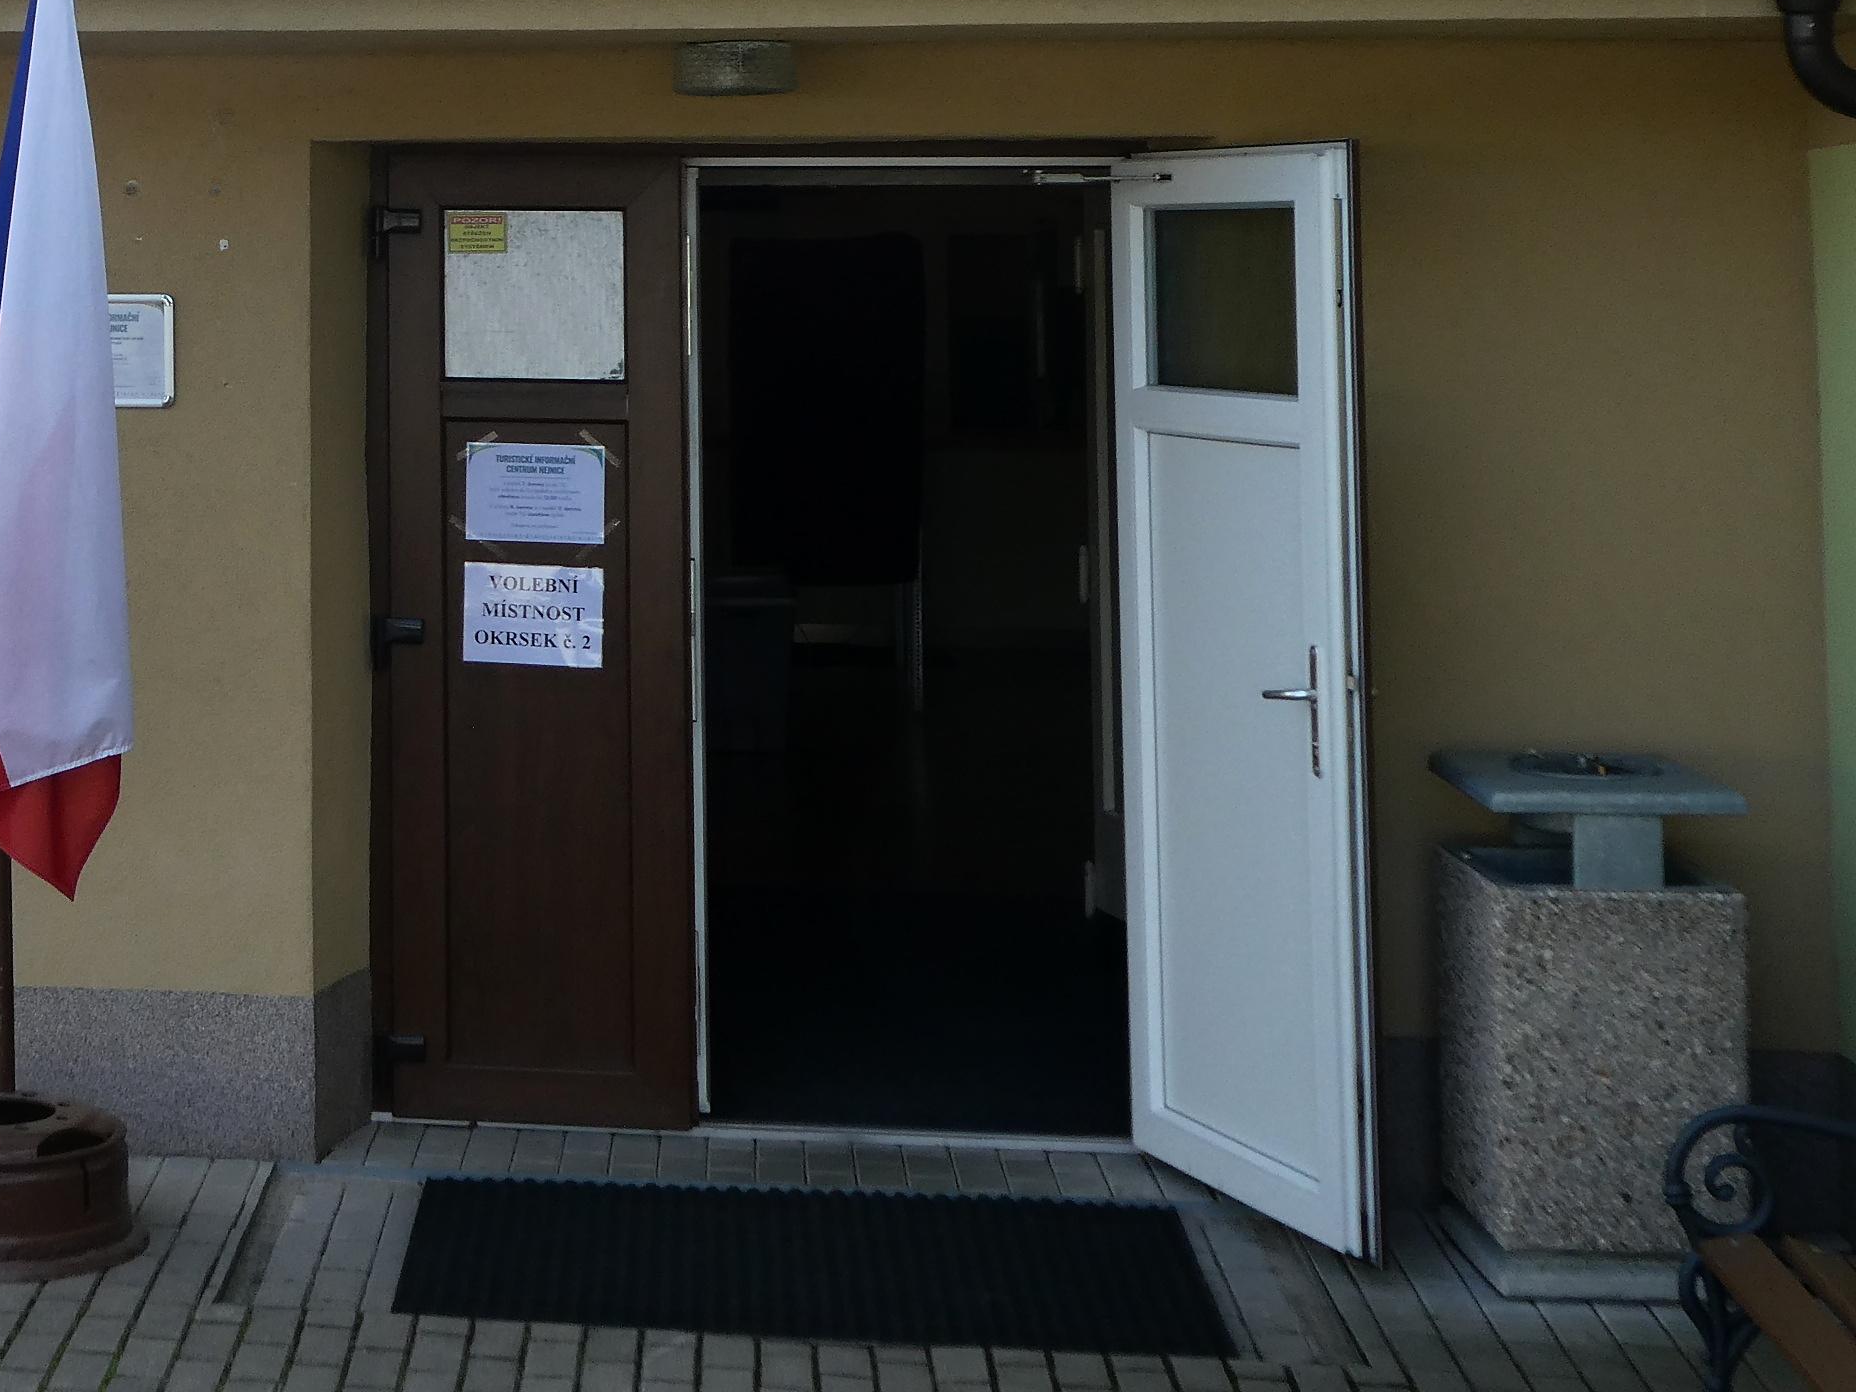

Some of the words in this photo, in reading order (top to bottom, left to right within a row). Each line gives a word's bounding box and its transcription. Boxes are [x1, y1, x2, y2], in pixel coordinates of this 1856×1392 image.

[495, 454, 534, 465] TURISTICKÉ
[534, 454, 576, 465] INFORMAČNÍ
[506, 465, 538, 474] CENTRUM
[489, 574, 579, 594] VOLEBNÍ
[482, 599, 586, 622] MÍSTNOST
[474, 629, 558, 649] OKRSEK
[563, 633, 576, 649] č.
[582, 634, 591, 650] 2
